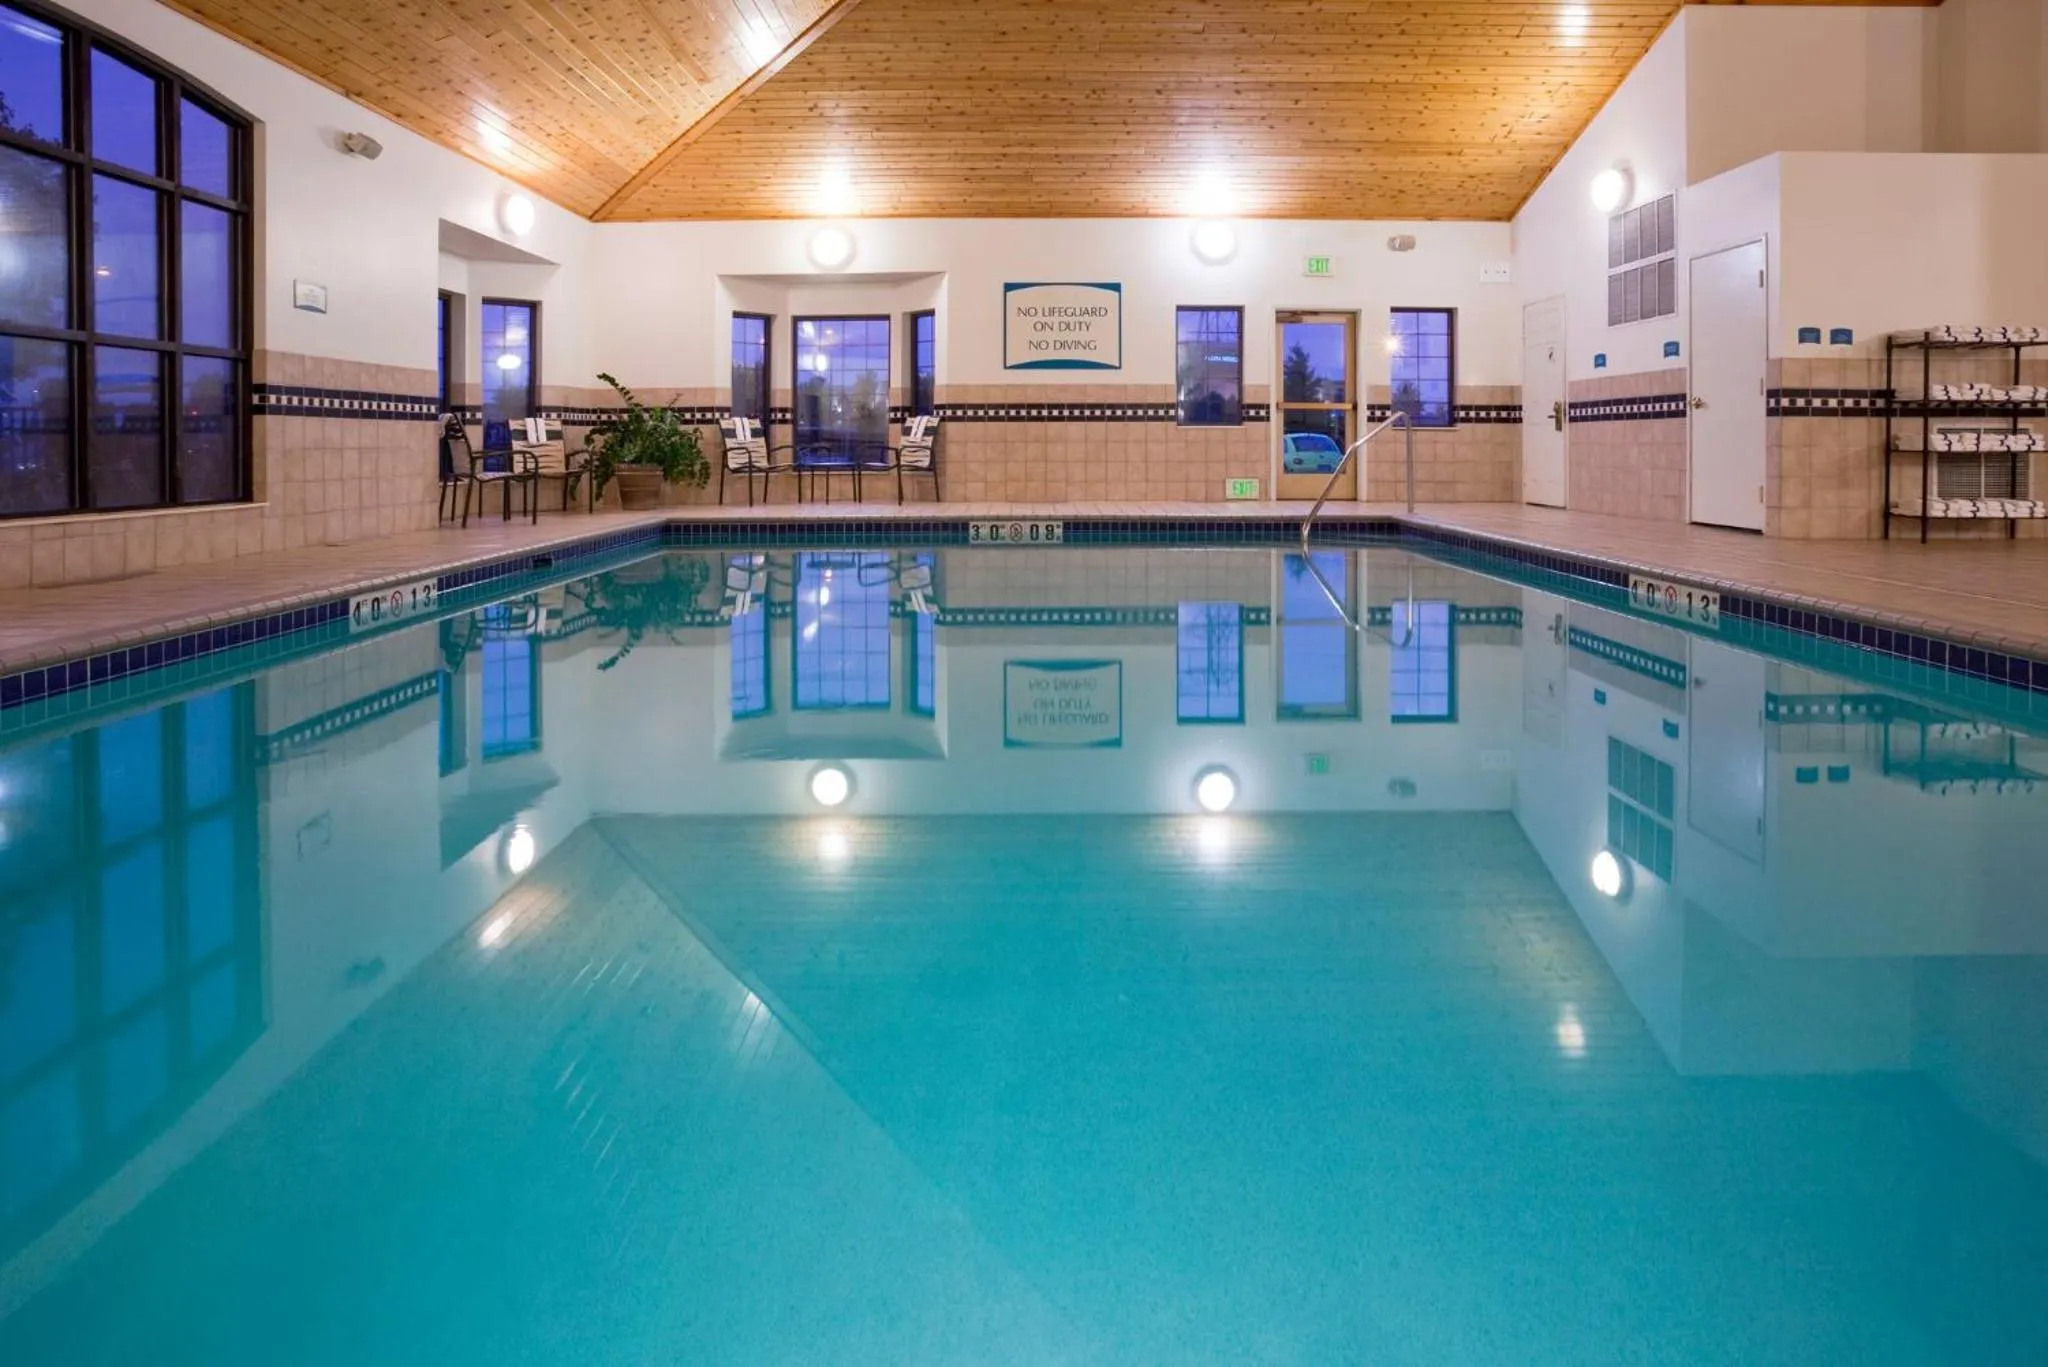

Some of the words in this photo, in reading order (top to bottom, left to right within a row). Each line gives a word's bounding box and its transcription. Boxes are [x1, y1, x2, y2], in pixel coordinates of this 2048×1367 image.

[1017, 306, 1038, 317] NO
[1042, 306, 1108, 317] LIFEGUARD
[1033, 320, 1054, 332] ON
[1058, 320, 1092, 332] DUTY
[1028, 340, 1049, 351] NO
[1053, 340, 1097, 351] DIVING
